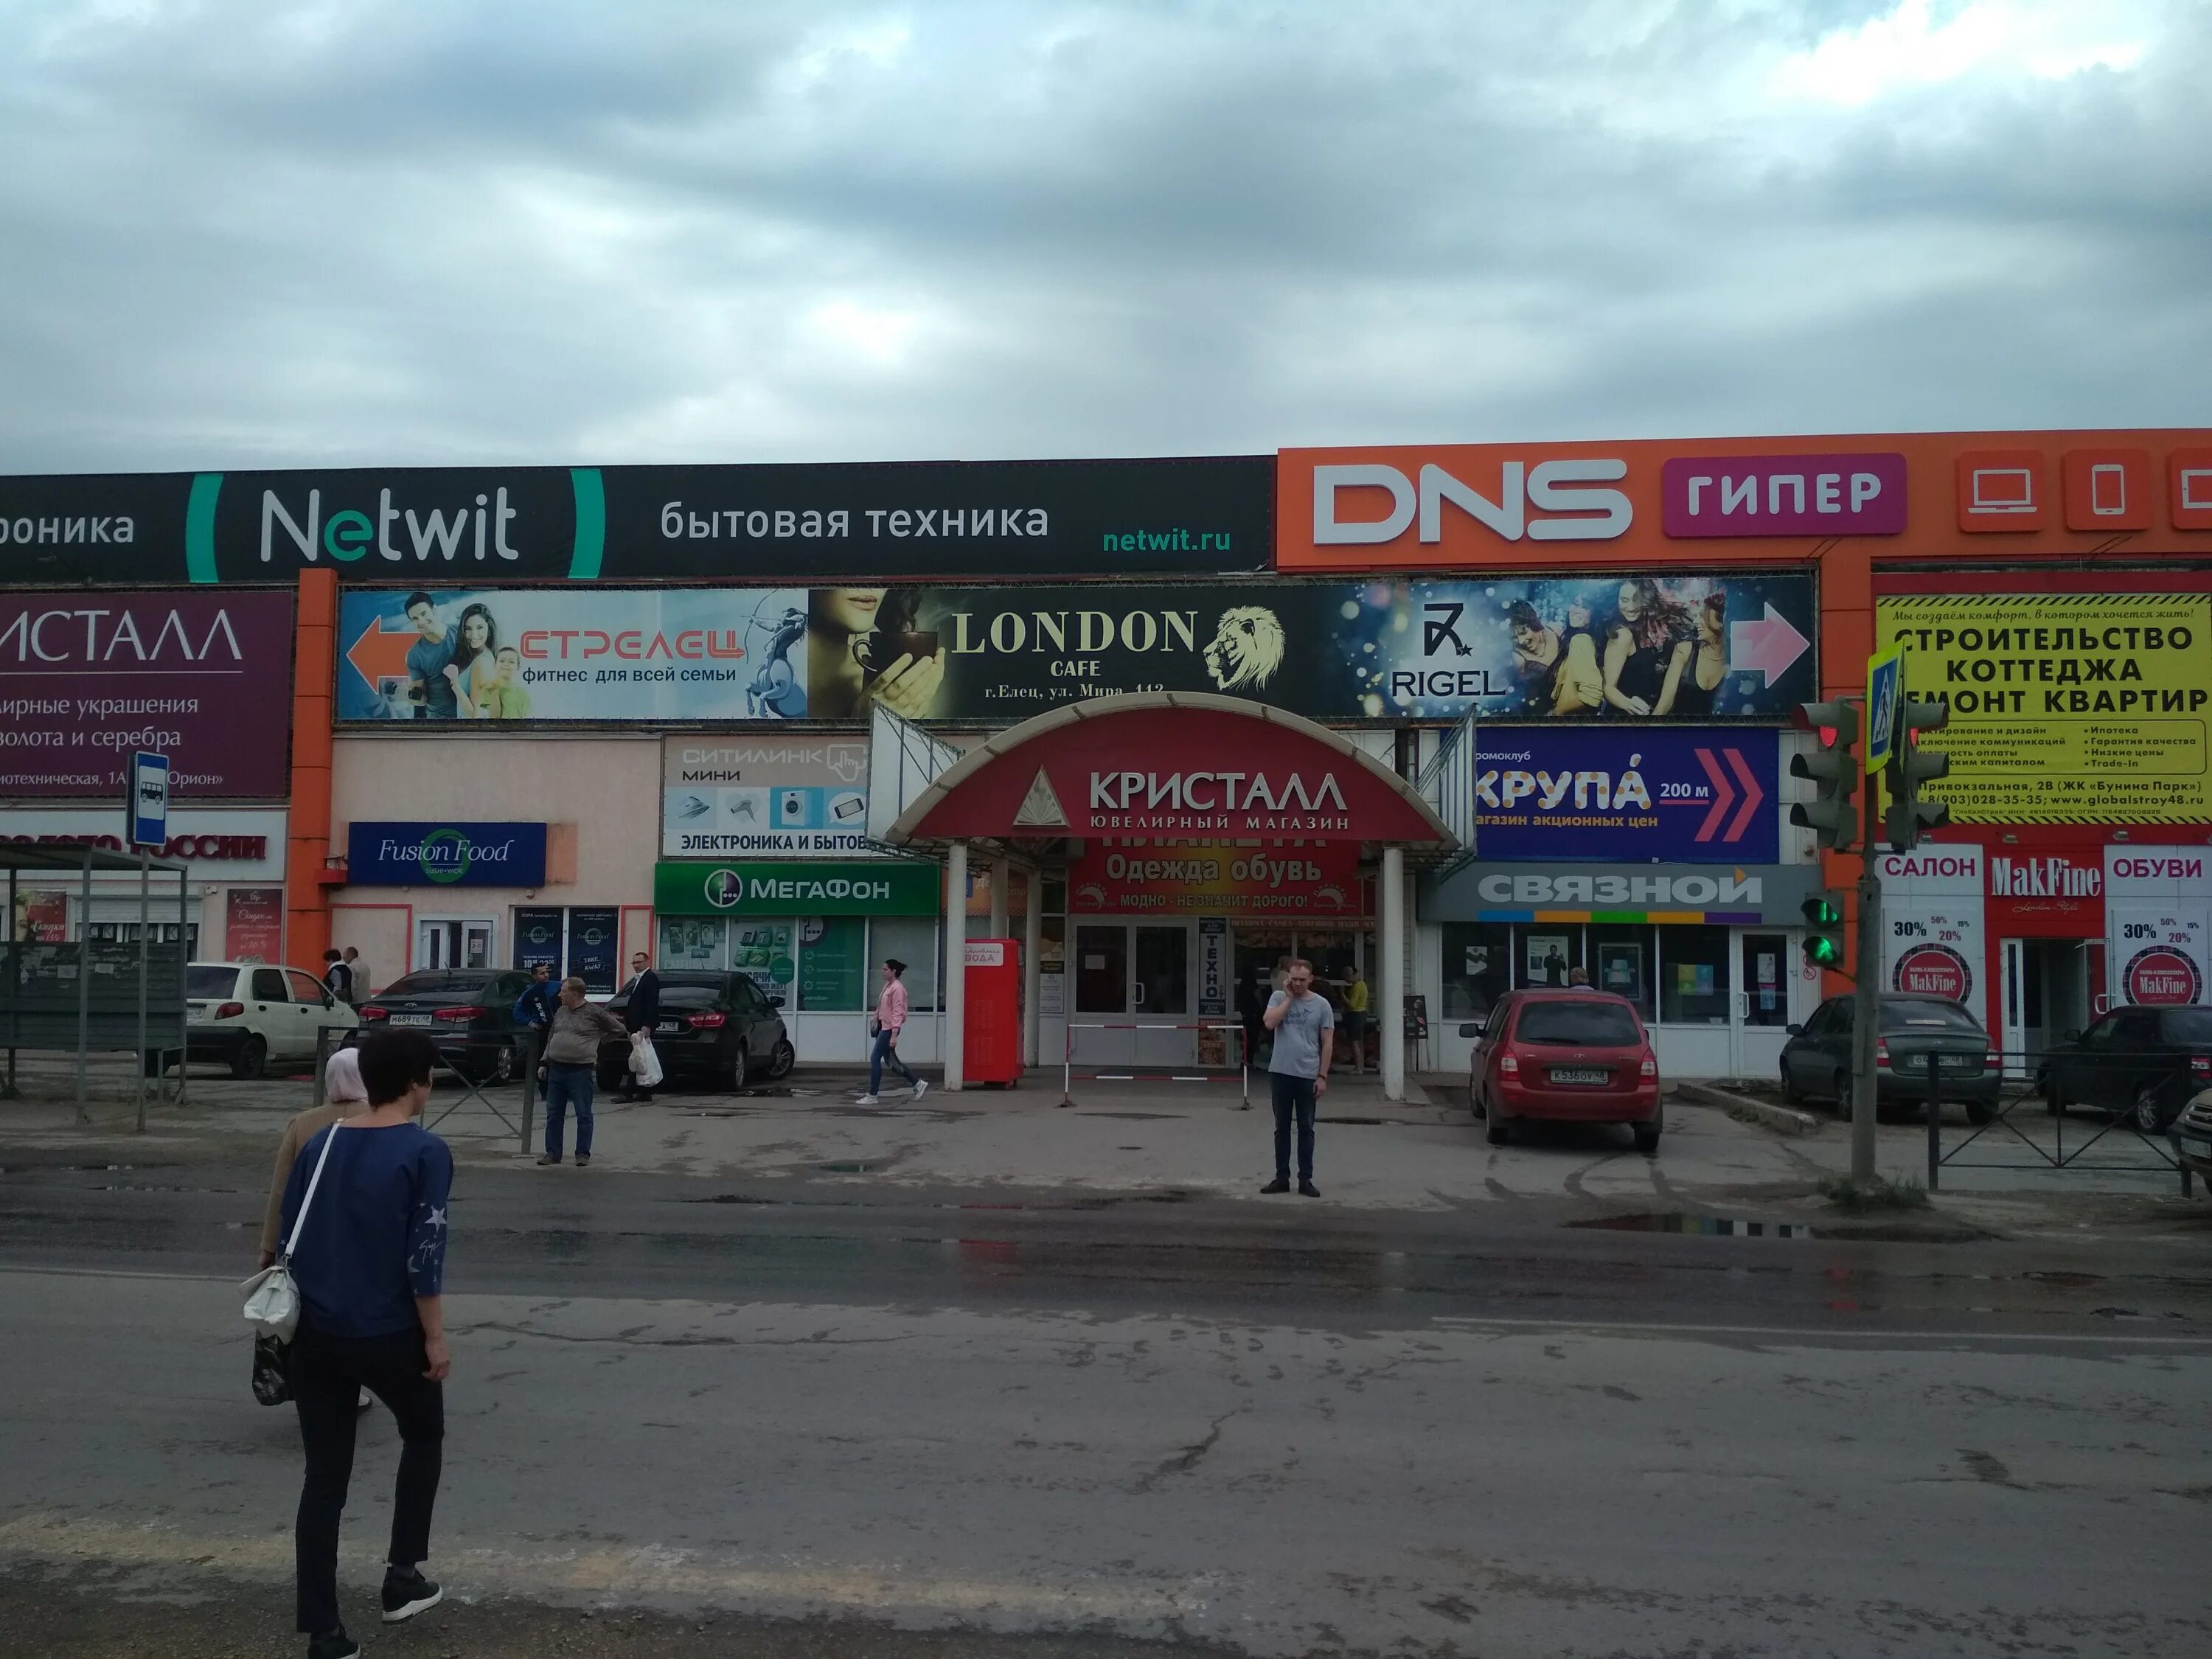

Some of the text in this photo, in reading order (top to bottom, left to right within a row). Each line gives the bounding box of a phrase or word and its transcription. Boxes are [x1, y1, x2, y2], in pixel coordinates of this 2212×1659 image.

[1312, 458, 1633, 546] DNS
[1688, 472, 1882, 515] ГИПЕР
[260, 487, 519, 563] Netwit
[661, 501, 1048, 539] бытовая техника
[1102, 527, 1231, 552] netwit.ru
[1893, 610, 1913, 622] Мы
[1916, 608, 1966, 625] создаём
[2045, 611, 2100, 623] котором
[2102, 610, 2154, 619] хочется
[2155, 608, 2194, 619] жить!
[950, 610, 1198, 654] LONDON
[520, 630, 745, 660] СТРЕЛЕЦ
[521, 666, 737, 685] фитнес для всей семьи
[1049, 660, 1102, 678] CAFE
[1947, 658, 2143, 686] КОТТЕДЖА
[1391, 670, 1506, 698] RIGEL
[1048, 687, 1073, 701] ул.
[2045, 689, 2208, 713] КВАРТИР
[0, 698, 199, 721] ирные украшения
[2006, 726, 2047, 736] дизайн
[2090, 726, 2139, 734] Ипотека
[72, 732, 84, 747] и
[91, 726, 182, 753] серебра
[1980, 737, 2066, 747] коммуникаций
[2091, 737, 2143, 747] Гарантия
[682, 748, 823, 765] СИТИЛИНК
[2091, 748, 2164, 758] Низкие цены
[1980, 759, 2045, 767] капиталом
[2092, 759, 2139, 768] Trade-In
[682, 770, 740, 782] МИНИ
[1090, 771, 1348, 811] КРИСТАЛЛ
[1660, 782, 1709, 799] 200 м
[1919, 780, 2202, 793] Привокзальная, 2В (ЖК «Бунина Парк»)
[2051, 794, 2205, 807] www.globalstroy48.ru
[1091, 814, 1349, 830] ЮВЕЛИРНЫЙ МАГАЗИН
[1533, 815, 1623, 828] акционных
[1628, 816, 1658, 828] цен
[378, 838, 516, 862] Fusion Food
[681, 835, 793, 850] ЭЛЕКТРОНИКА
[797, 835, 810, 850] И
[1105, 846, 1322, 888] Одежда обувь
[1885, 857, 1976, 877] САЛОН
[2112, 858, 2203, 879] ОБУВИ
[1990, 858, 2101, 897] MakFine
[1120, 894, 1166, 908] МОДНО
[1177, 894, 1194, 908] НЕ
[1197, 894, 1248, 908] ЗНАЧИТ
[1253, 894, 1308, 909] ДОРОГО!
[1894, 922, 1927, 937] 30%
[1930, 917, 1947, 925] 50%
[2160, 918, 2177, 926] 50%
[1939, 931, 1961, 942] 20%
[2124, 923, 2157, 939] 30%
[2168, 932, 2191, 943] 20%
[1206, 935, 1218, 998] ТЕХНО
[1910, 973, 1956, 992] MakFine
[2139, 976, 2186, 995] MakFine
